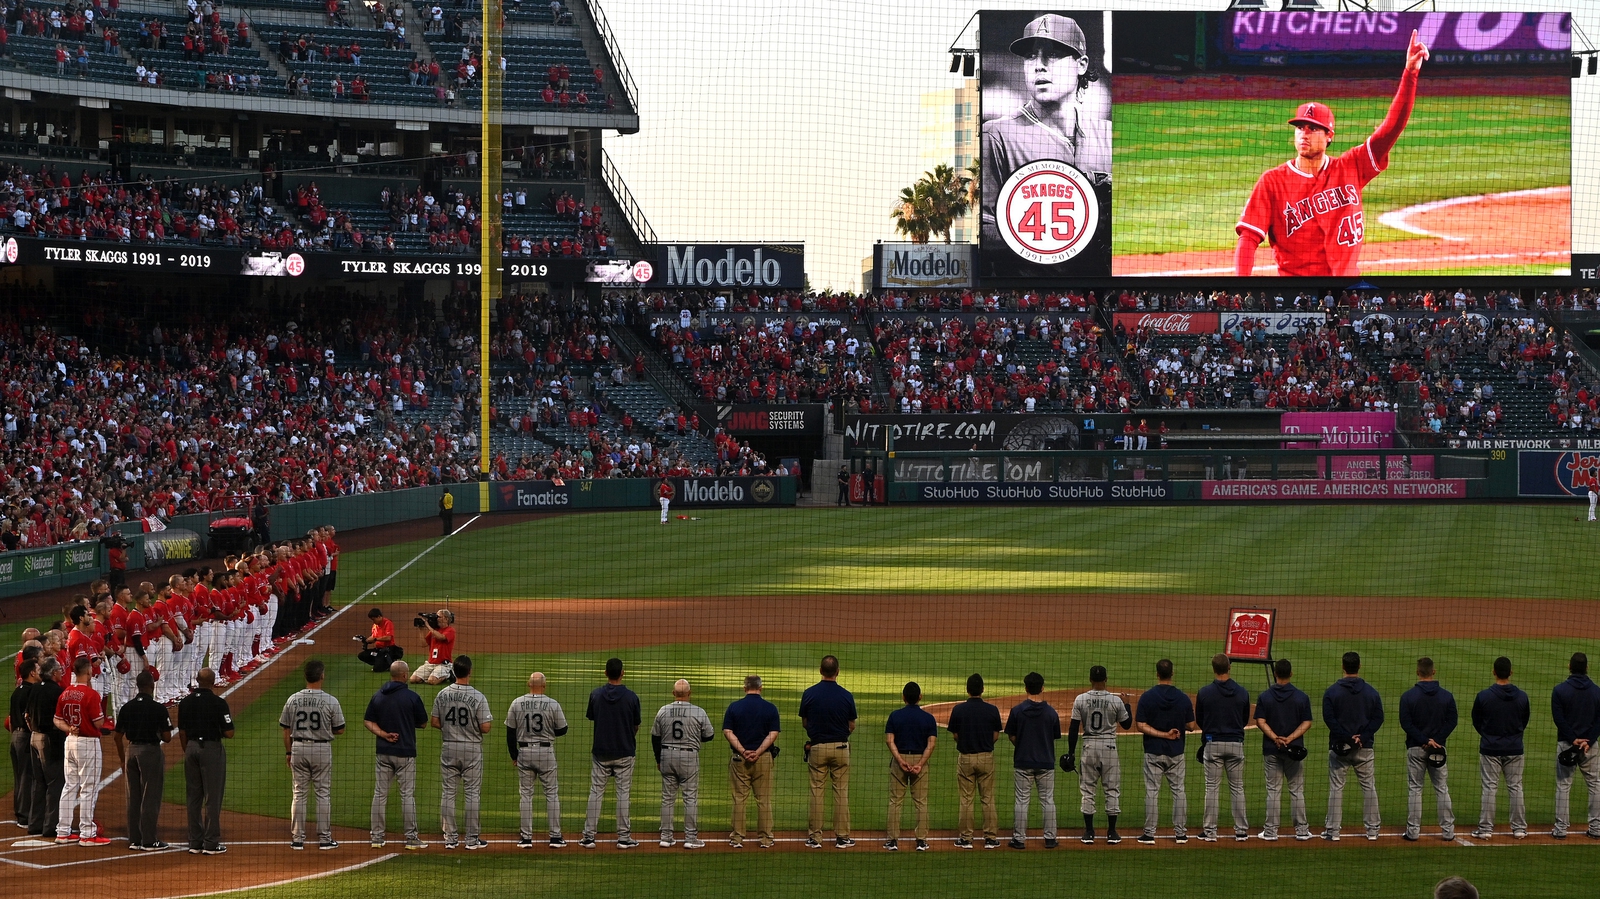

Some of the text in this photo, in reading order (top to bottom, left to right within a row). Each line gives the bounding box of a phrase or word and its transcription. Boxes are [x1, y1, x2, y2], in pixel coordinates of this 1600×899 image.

[1233, 11, 1398, 34] KITCHENS
[1015, 163, 1080, 181] IN MEMORY OF
[1021, 183, 1074, 199] SKAGGS
[1283, 185, 1359, 238] ANGELS
[1018, 202, 1076, 241] 45
[1337, 211, 1365, 247] 45
[8, 246, 16, 259] 45
[44, 247, 82, 261] TYLER
[85, 249, 127, 264] SKAGGS
[132, 252, 161, 266] 1991
[180, 255, 211, 268] 2019
[288, 261, 302, 273] 45
[341, 260, 388, 274] TYLER
[393, 261, 450, 275] SKAGGS
[457, 263, 484, 275] 199
[511, 264, 548, 277] 2019
[666, 245, 781, 287] Modelo
[894, 250, 960, 276] Modelo
[635, 268, 650, 279] 45
[1138, 313, 1193, 332] Coca-Cola
[727, 411, 769, 430] JMG
[769, 411, 804, 420] SECURITY
[769, 420, 805, 430] SYSTEMS
[845, 419, 996, 444] NITOTIRE.COM
[1466, 439, 1550, 449] MLB NETWORK
[1577, 440, 1600, 449] MLB
[1491, 450, 1506, 460] 390
[1346, 460, 1380, 469] ANGELS
[580, 481, 592, 492] 347
[683, 480, 744, 501] Modelo
[923, 485, 1166, 499] StubHub StubHub StubHub StubHub
[1212, 483, 1457, 496] AMERICA'S GAME. AMERICA'S NETWORK.
[517, 489, 568, 506] Fanatics
[72, 547, 95, 563] National
[161, 538, 192, 559] CHANGE
[31, 553, 55, 570] National
[1238, 629, 1258, 645] 45
[292, 697, 326, 710] SERVAIS
[520, 700, 549, 711] PRIETO
[1086, 698, 1110, 709] SMITH
[63, 703, 81, 727] 45
[224, 713, 232, 724] 5
[296, 710, 321, 731] 29
[445, 706, 469, 727] 48
[670, 707, 688, 718] HILL
[1091, 710, 1103, 730] 0
[525, 713, 543, 733] 13
[673, 720, 684, 740] 6
